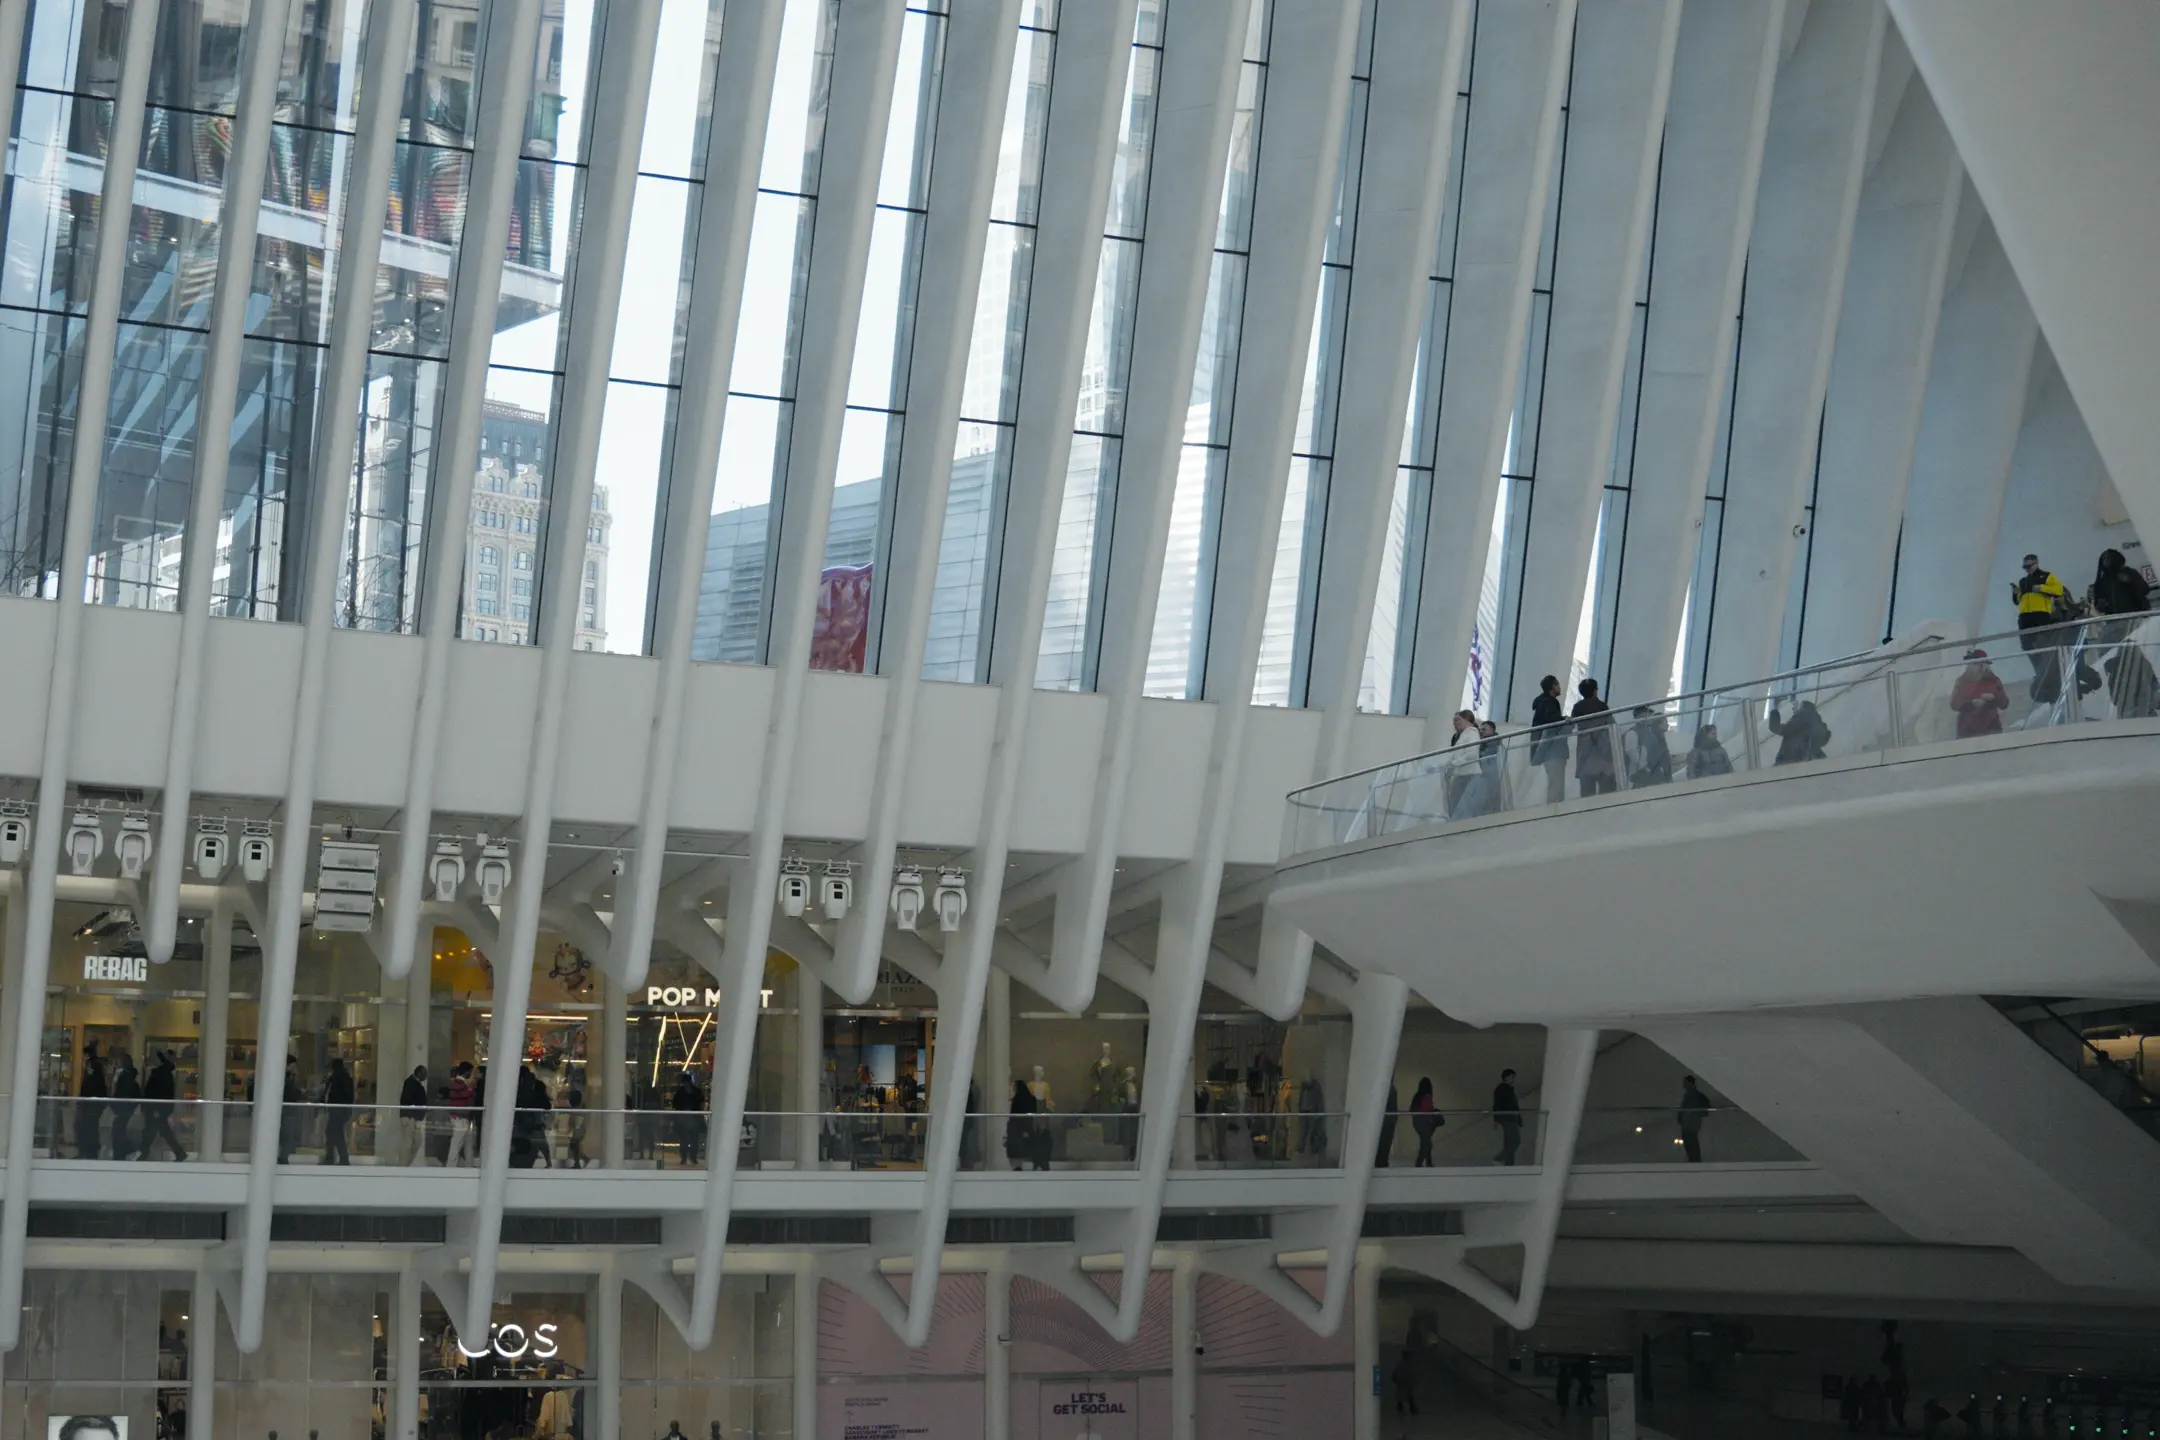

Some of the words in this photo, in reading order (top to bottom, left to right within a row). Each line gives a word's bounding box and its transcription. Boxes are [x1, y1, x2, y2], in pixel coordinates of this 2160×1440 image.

[84, 955, 148, 981] REBAG
[647, 986, 697, 1007] POP
[705, 988, 774, 1008] MT
[1071, 1392, 1107, 1404] LET'S
[1053, 1404, 1078, 1415] GET
[1080, 1402, 1127, 1414] SOCIAL
